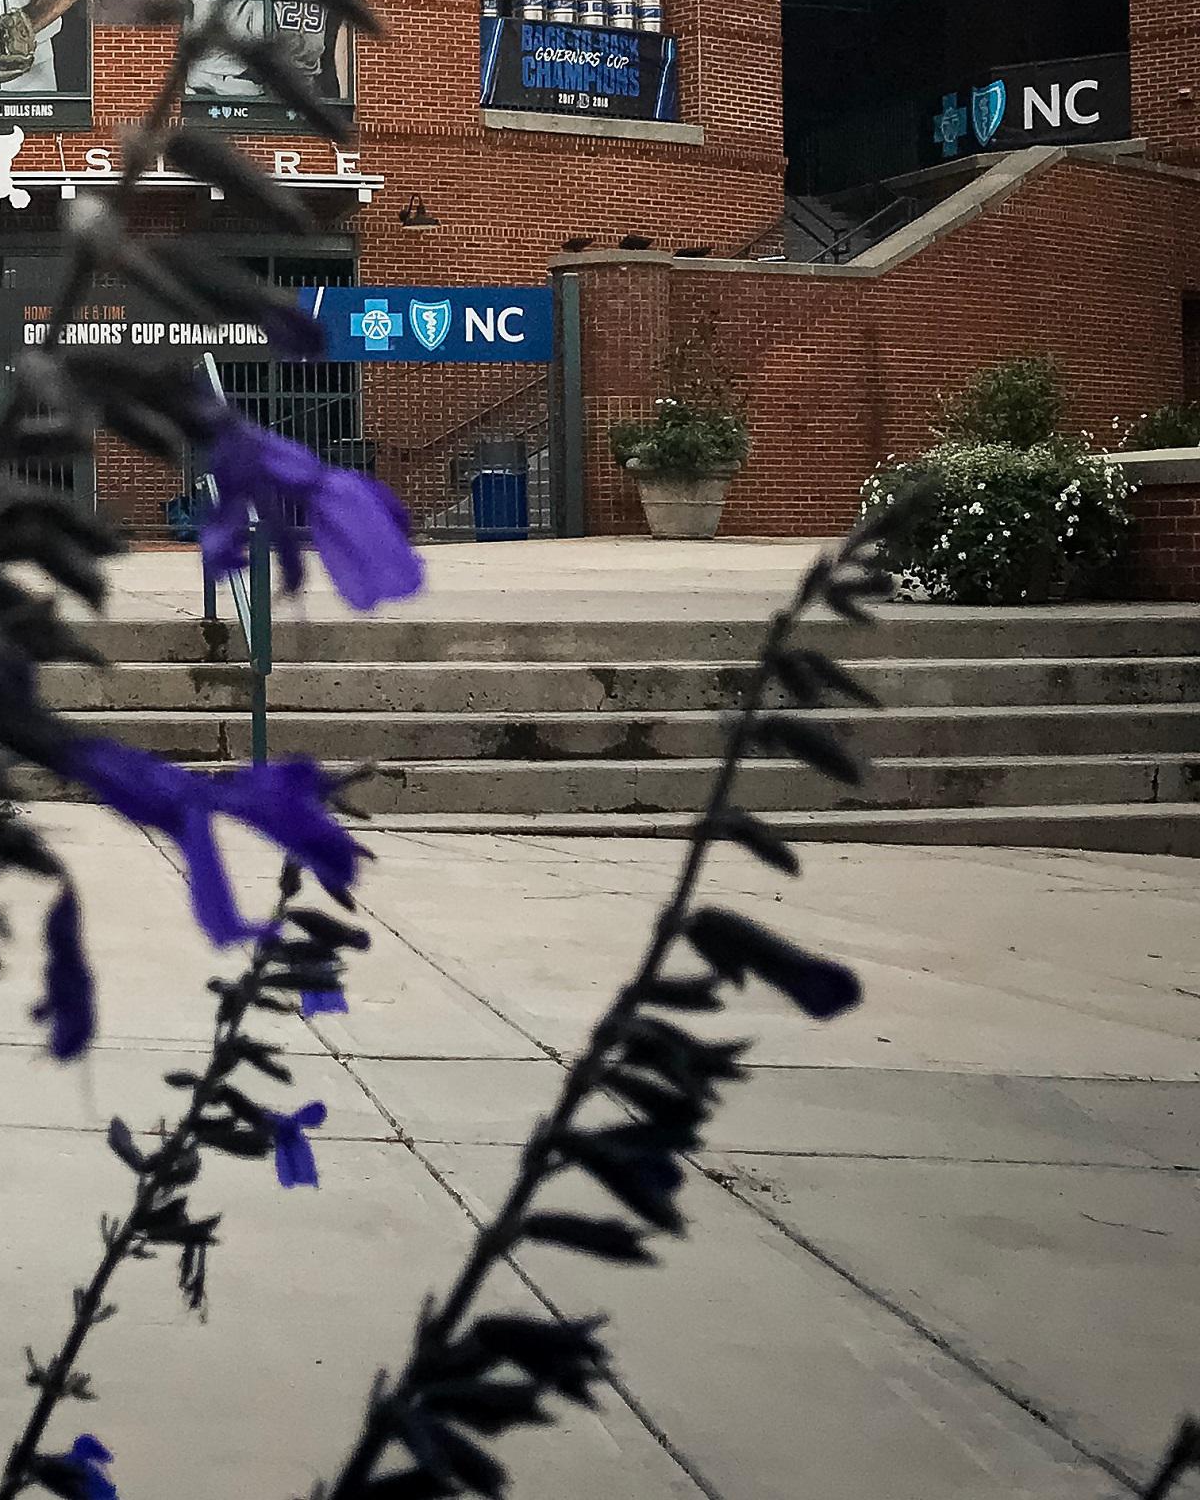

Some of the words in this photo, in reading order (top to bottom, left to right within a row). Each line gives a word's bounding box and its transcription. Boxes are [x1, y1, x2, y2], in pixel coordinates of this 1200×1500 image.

[279, 0, 324, 33] 29
[535, 47, 603, 67] GOVERNORS'
[606, 55, 629, 69] CUP
[522, 56, 640, 97] CHAMPIONS
[31, 104, 53, 116] FANS
[234, 109, 248, 117] NC
[1023, 80, 1100, 130] NC
[85, 149, 361, 176] SRE
[23, 323, 127, 345] GOERNORS'
[131, 323, 165, 345] CUP
[169, 323, 268, 345] CHAMPIONS
[465, 306, 525, 342] NC
